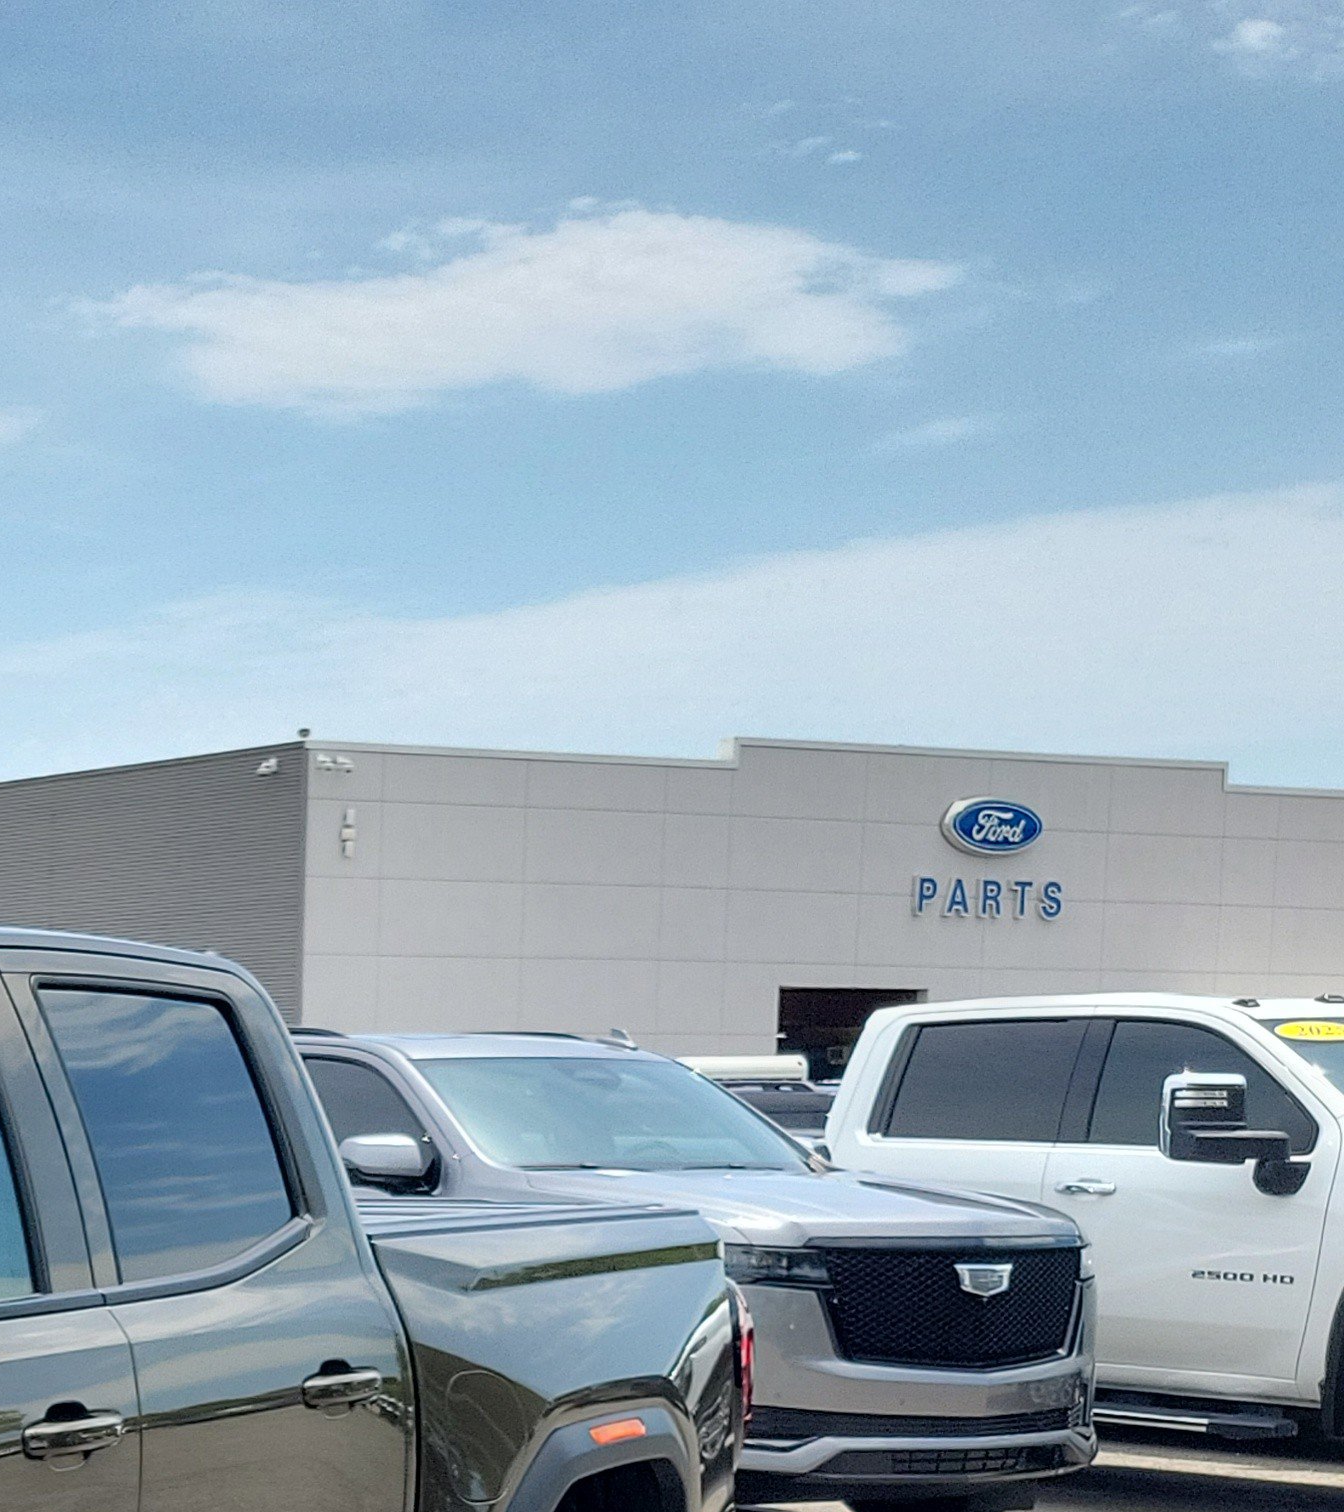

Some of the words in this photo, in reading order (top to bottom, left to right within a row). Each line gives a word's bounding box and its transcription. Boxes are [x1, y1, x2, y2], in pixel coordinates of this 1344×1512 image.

[971, 810, 1026, 843] Ford
[916, 877, 1063, 918] PARTS
[1191, 1269, 1255, 1282] 2500
[1262, 1274, 1295, 1285] HD
